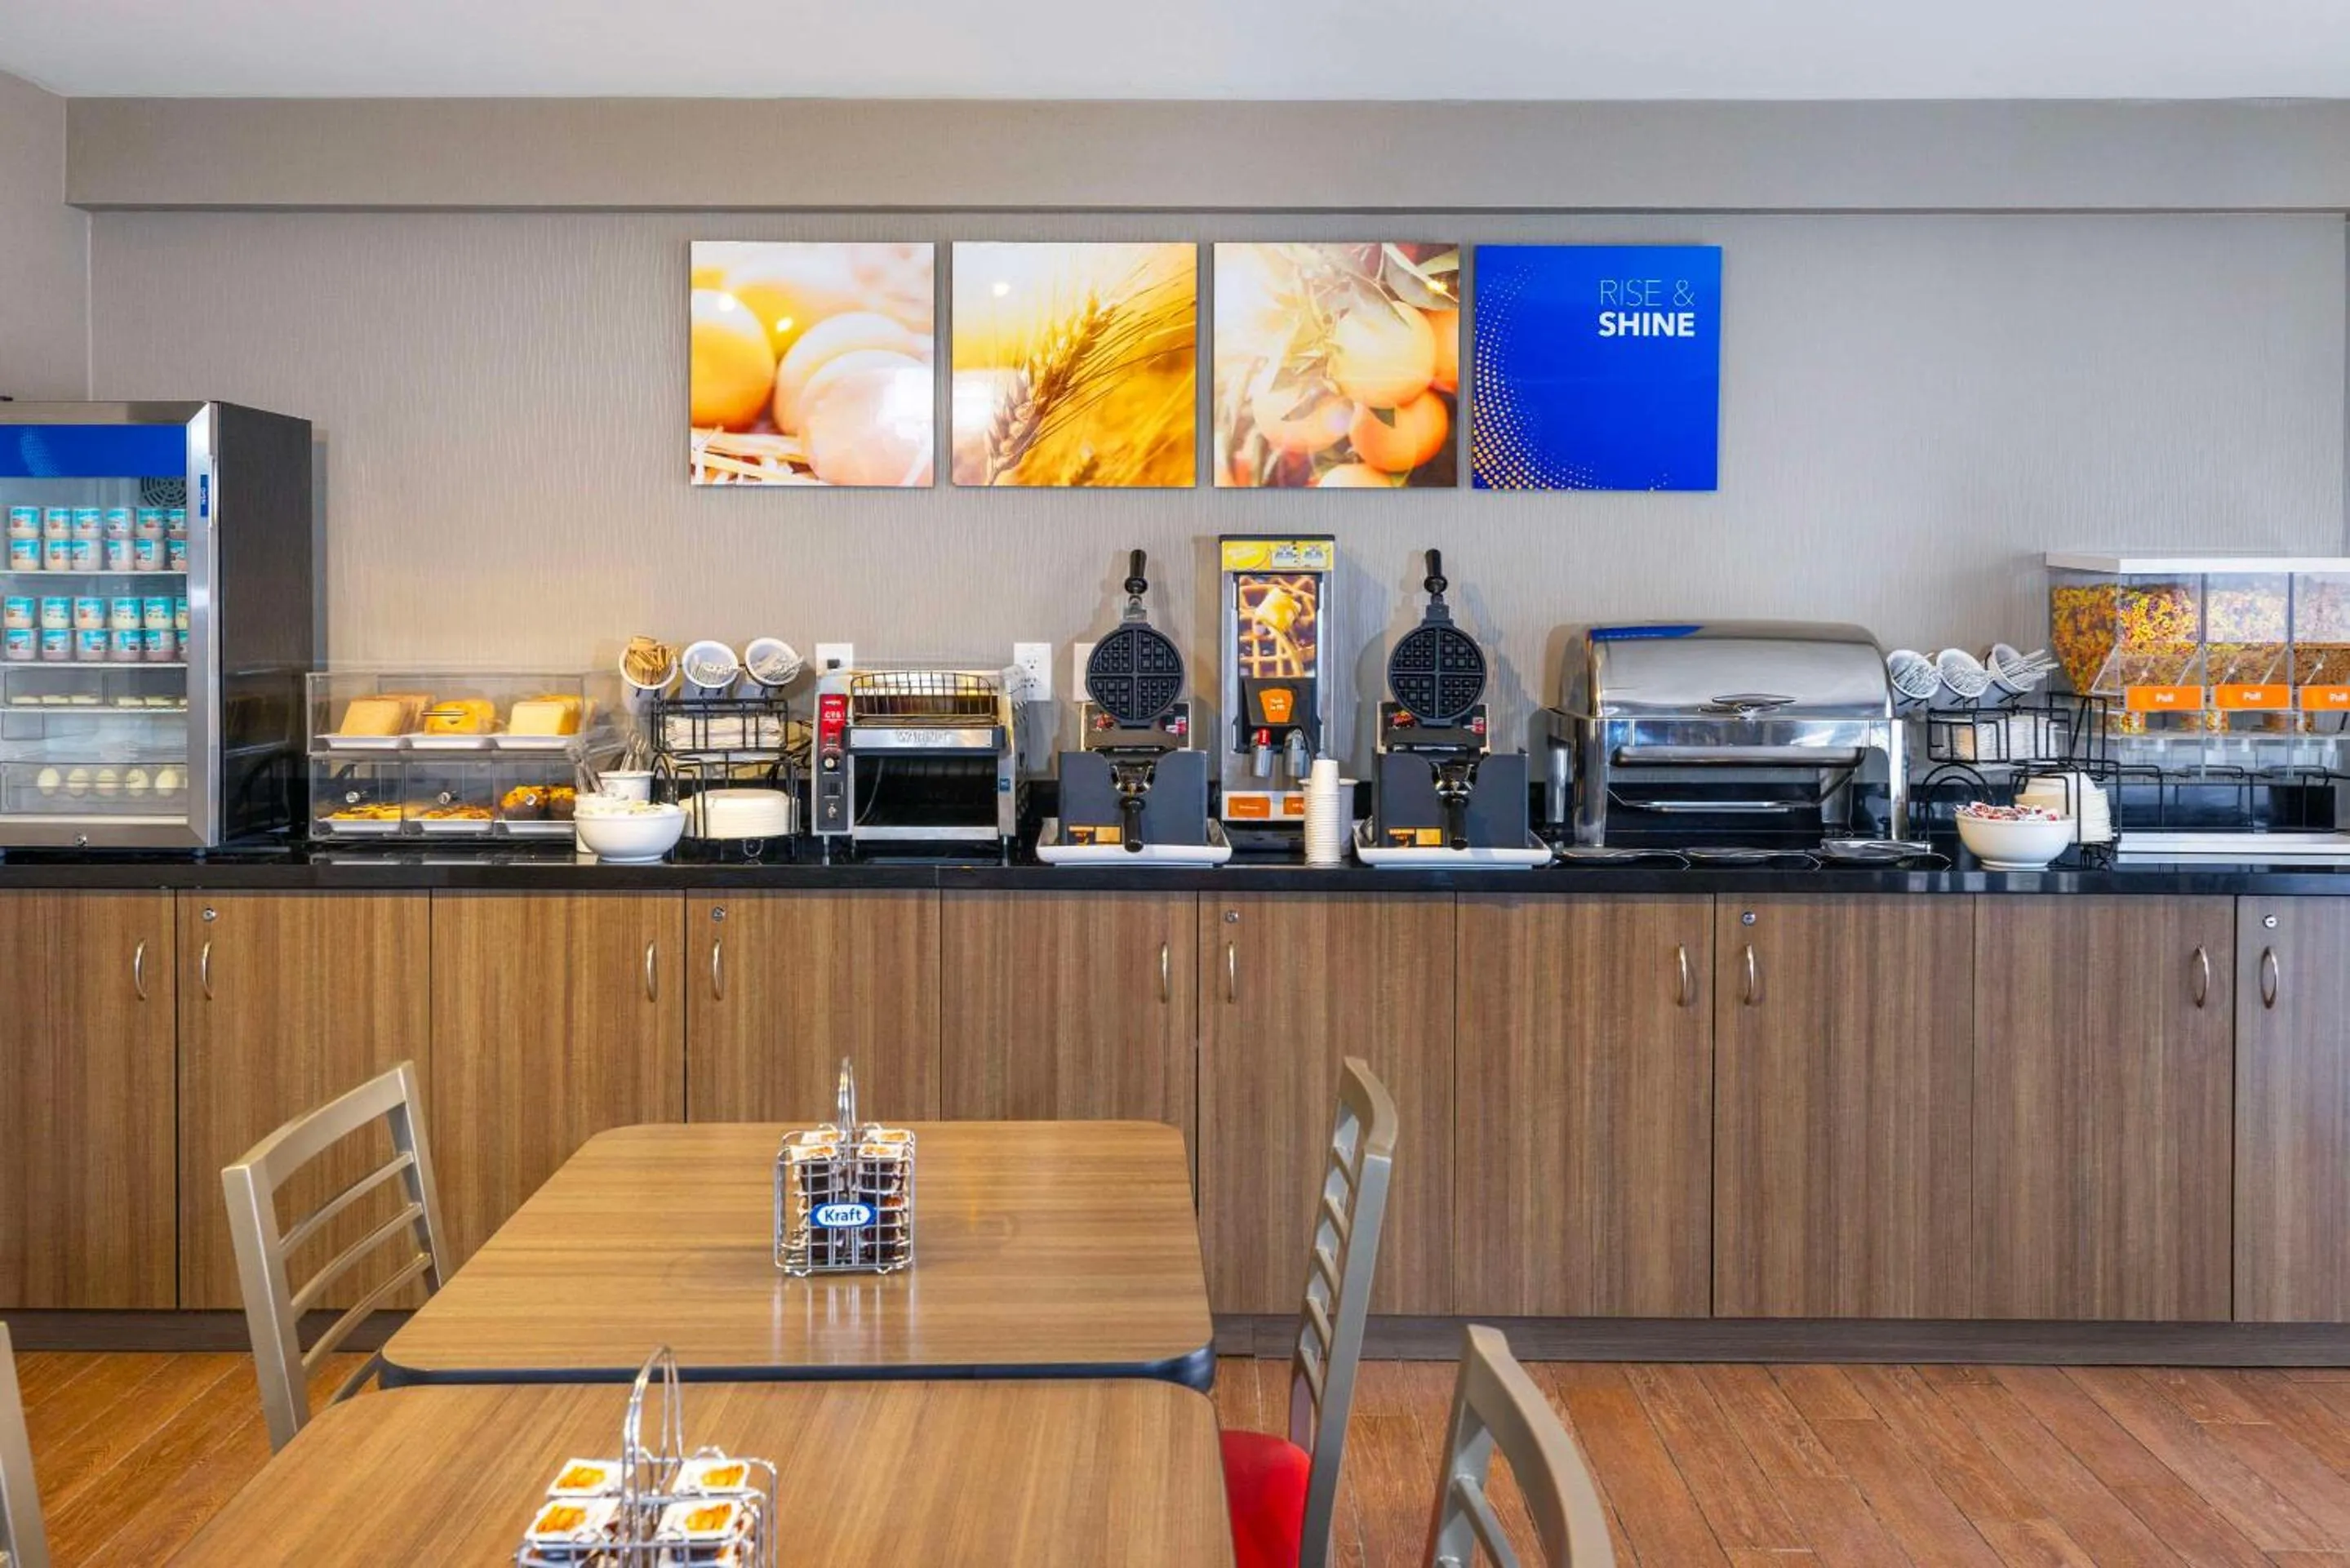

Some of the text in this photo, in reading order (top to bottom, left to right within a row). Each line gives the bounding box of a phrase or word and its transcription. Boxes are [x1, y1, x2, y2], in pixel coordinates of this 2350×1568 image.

[1600, 278, 1695, 307] RISE &
[1598, 311, 1696, 337] SHINE
[824, 1207, 862, 1222] Kraft
